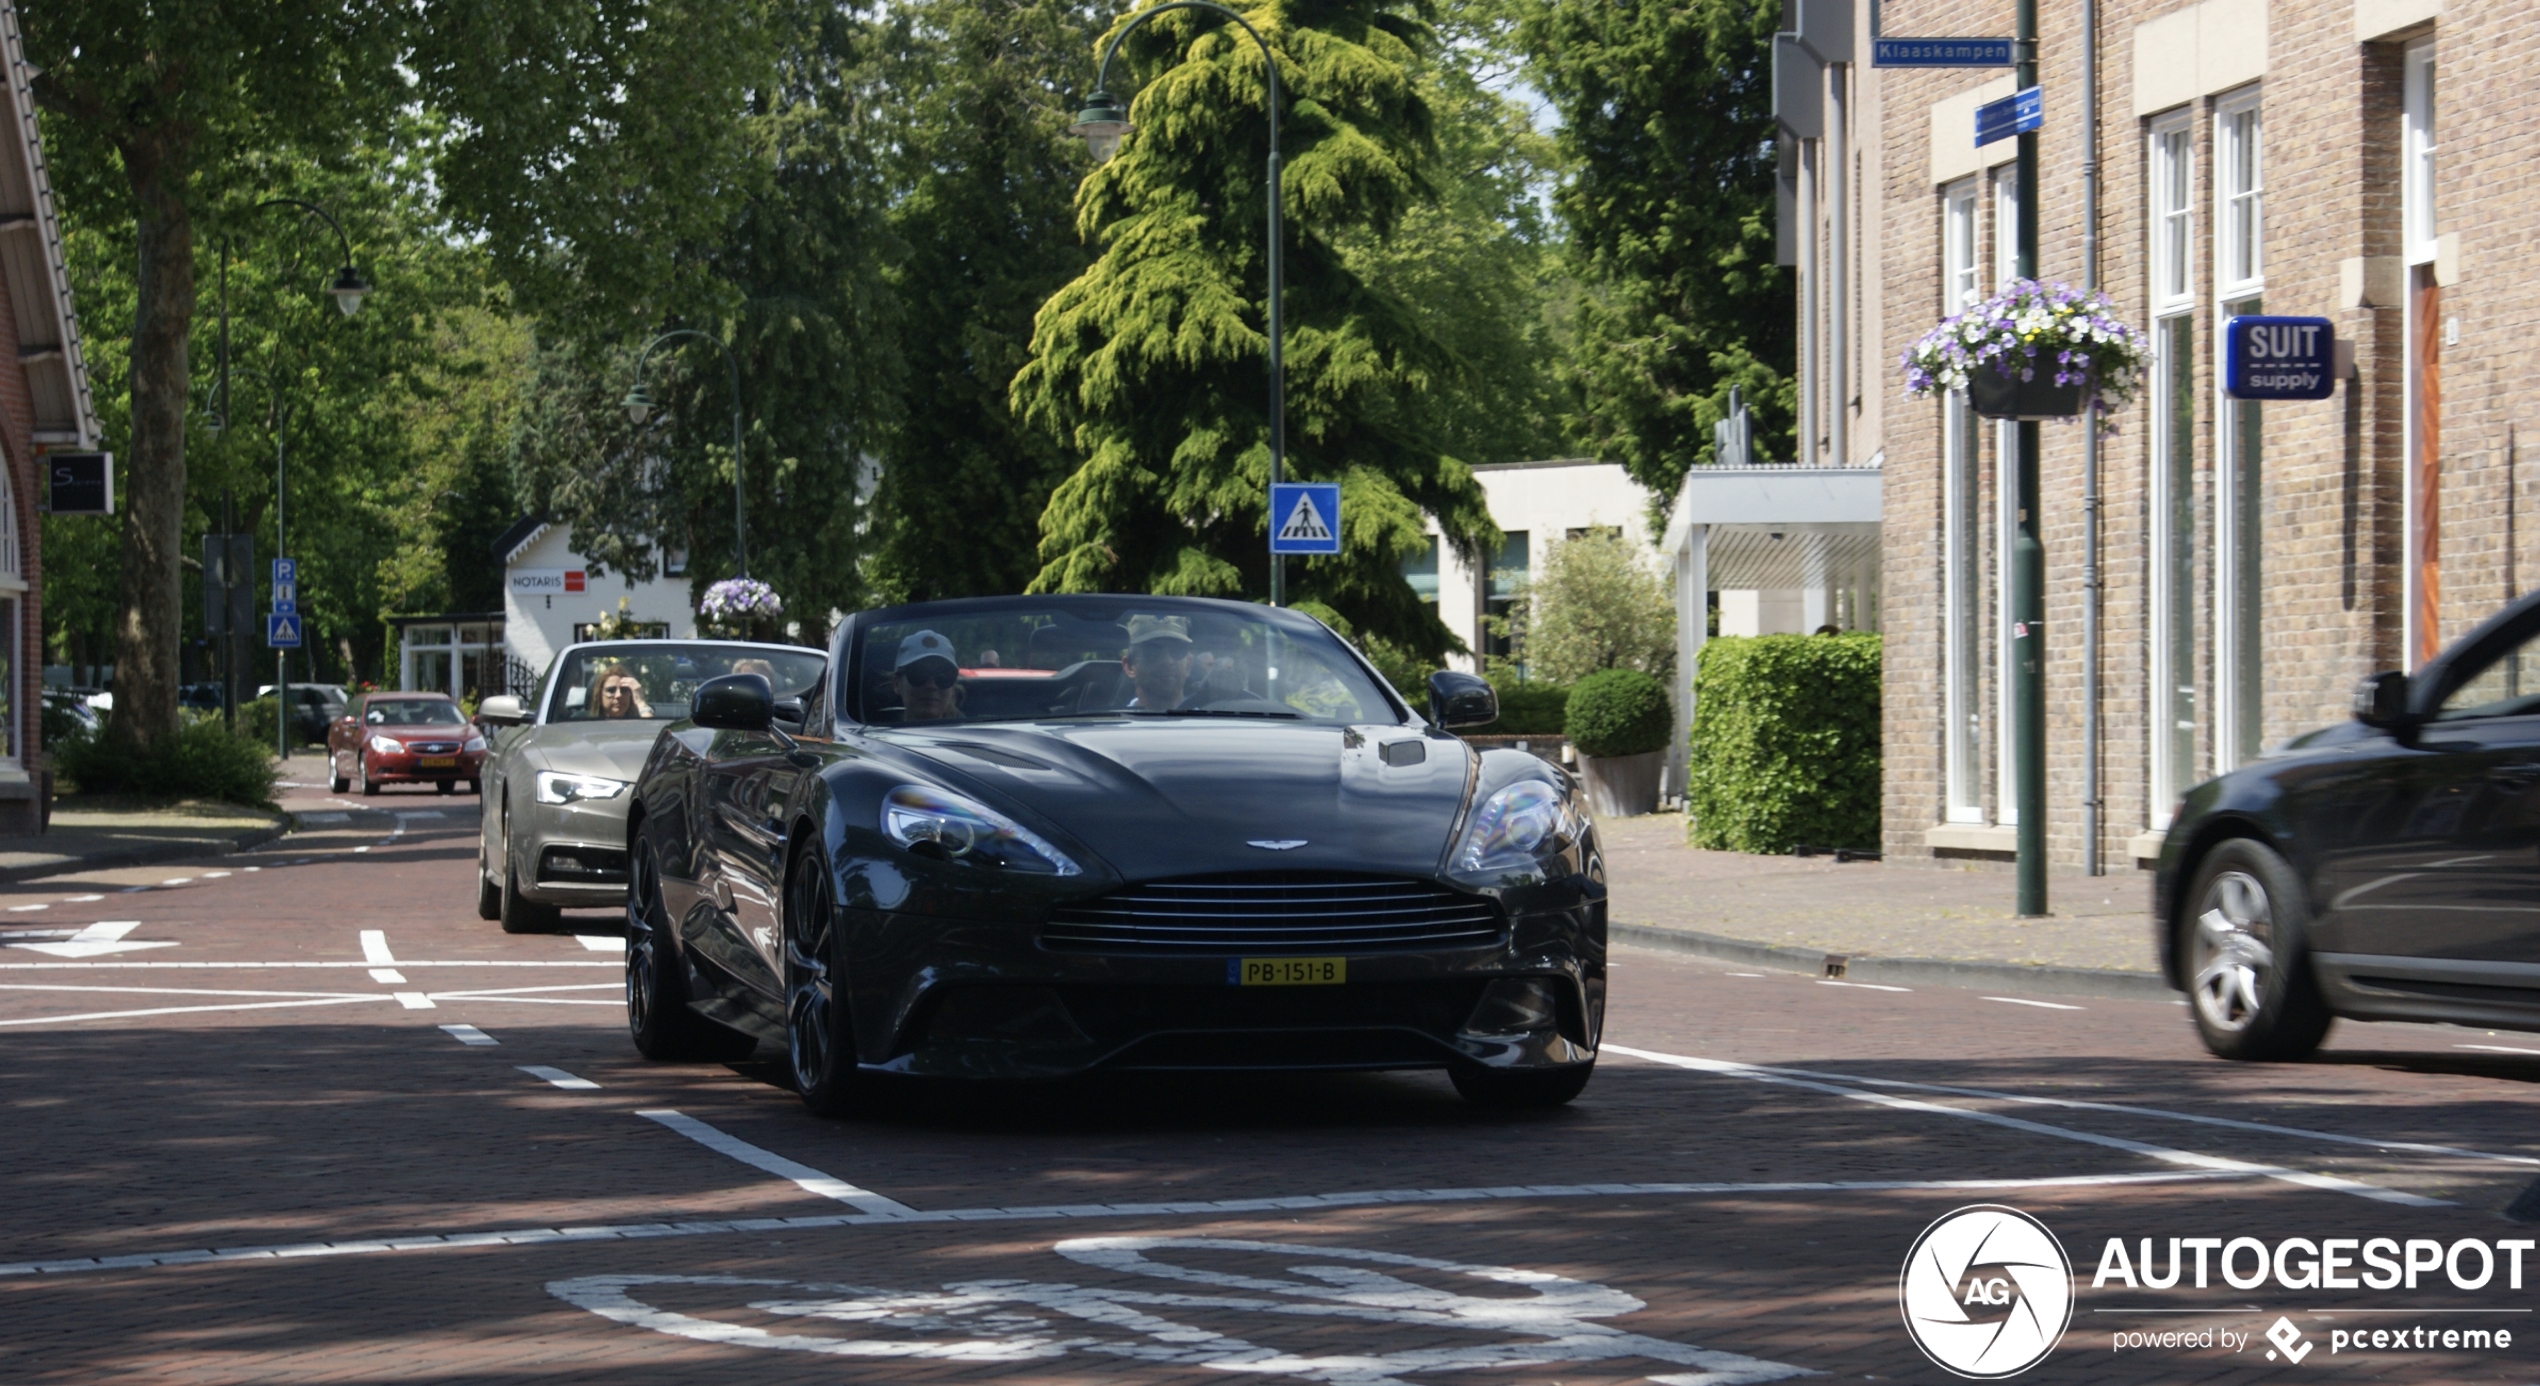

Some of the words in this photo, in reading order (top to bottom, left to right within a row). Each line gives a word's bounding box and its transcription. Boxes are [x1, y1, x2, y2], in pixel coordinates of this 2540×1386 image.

[1878, 43, 2007, 61] Klaaskampen
[2249, 325, 2321, 359] SUIT
[2249, 371, 2321, 391] supply
[513, 576, 562, 588] NOTARIS
[1247, 962, 1335, 982] PB-151-B
